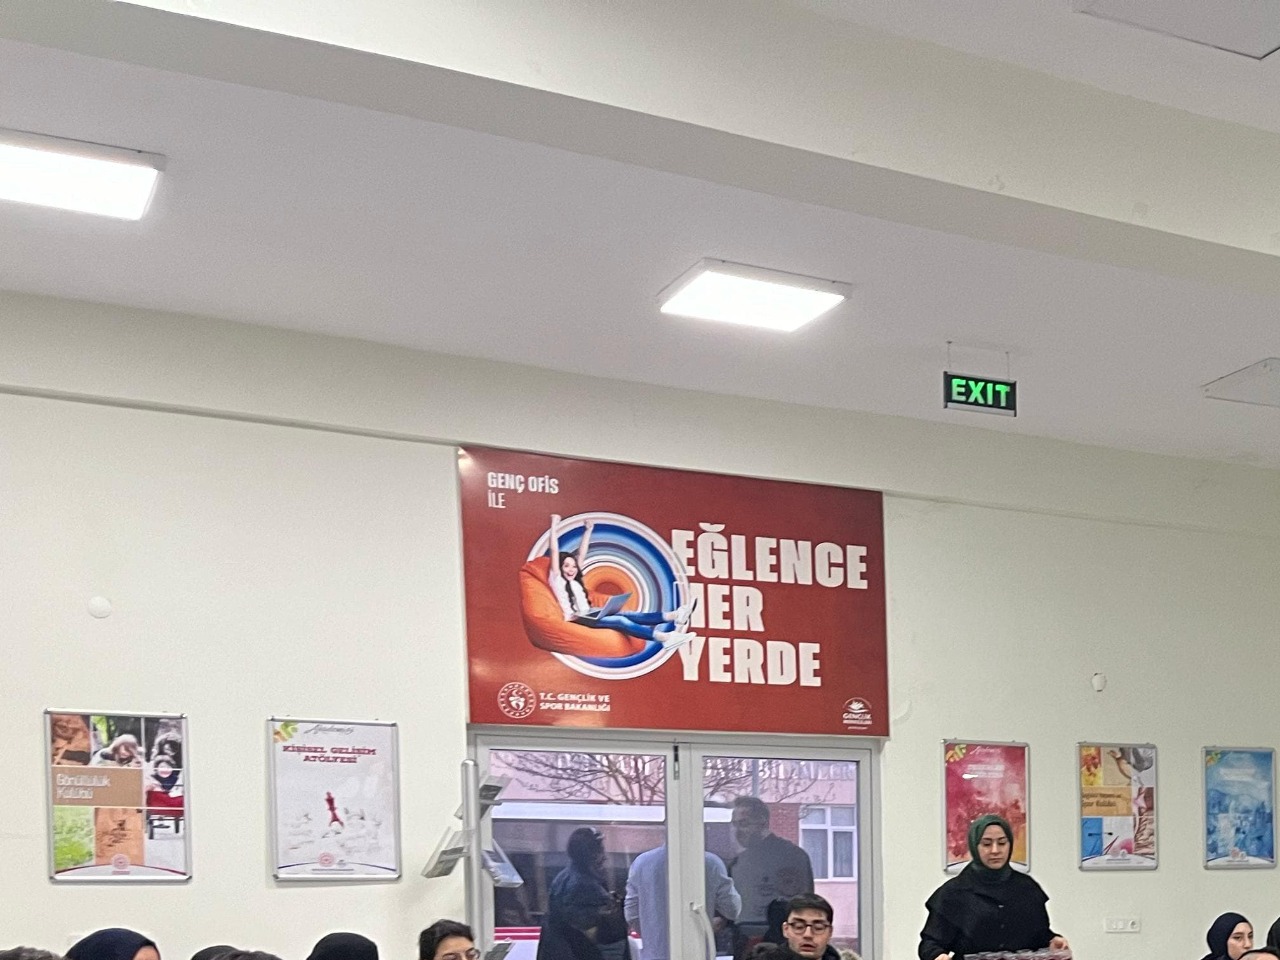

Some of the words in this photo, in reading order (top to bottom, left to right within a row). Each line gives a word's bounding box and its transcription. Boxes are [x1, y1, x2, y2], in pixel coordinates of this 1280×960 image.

[951, 378, 1010, 407] EXIT
[487, 471, 525, 493] GENÇ
[527, 475, 559, 494] OFİS
[487, 489, 506, 509] İLE
[671, 522, 868, 589] EĞLENCE
[677, 635, 822, 687] YERDE
[539, 702, 563, 710] SPOR
[597, 694, 610, 703] VE
